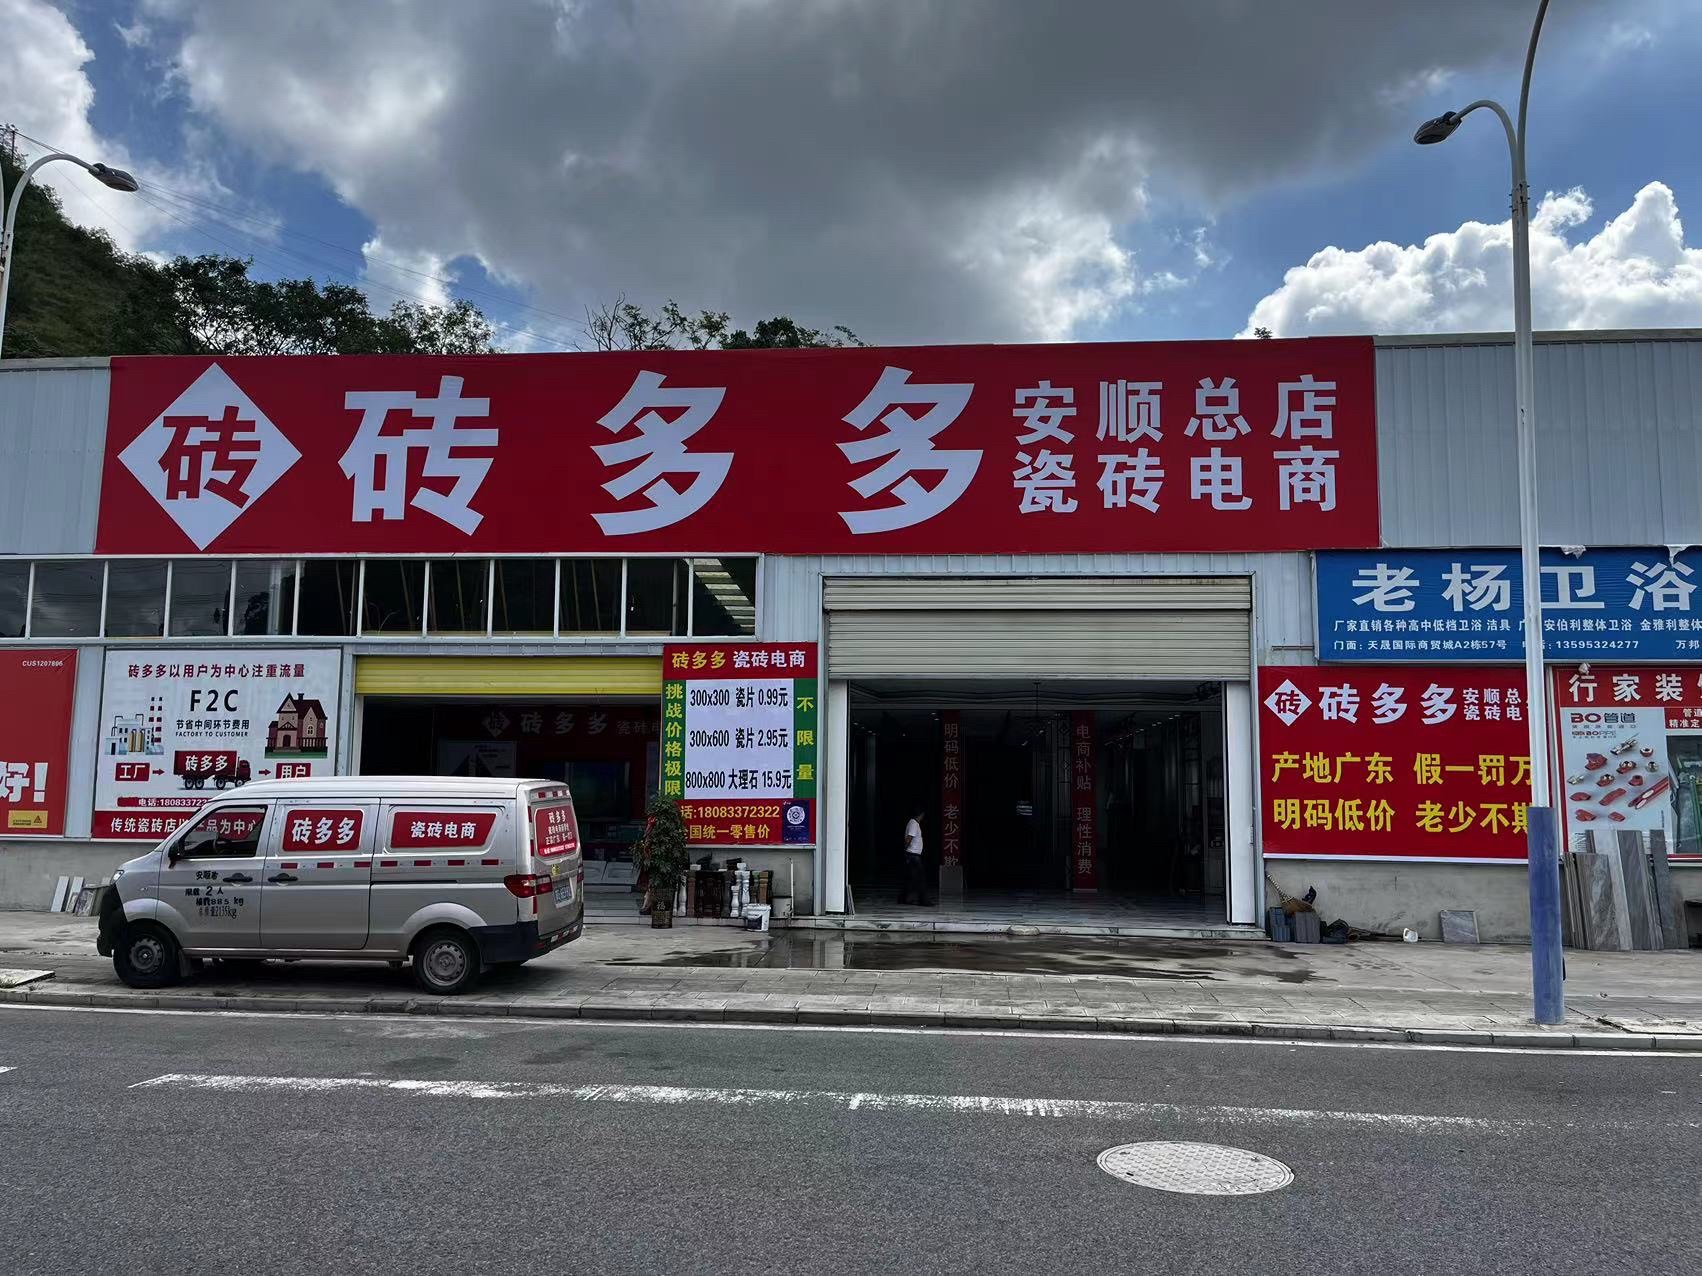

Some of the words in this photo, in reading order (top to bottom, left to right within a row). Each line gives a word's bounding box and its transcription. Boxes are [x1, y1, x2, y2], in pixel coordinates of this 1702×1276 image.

[1013, 374, 1337, 444] 安顺总店
[158, 405, 261, 509] 砖
[338, 366, 983, 537] 砖多多
[1013, 446, 1340, 514] 瓷砖电商
[1352, 561, 1697, 612] 老杨卫浴
[1519, 618, 1632, 632] 安伯利整体卫浴
[128, 663, 305, 678] 砖多多以用户为中心注重流量
[672, 650, 726, 669] 砖多多
[733, 650, 806, 669] 瓷砖电商
[190, 690, 239, 712] F2C
[690, 690, 730, 706] 300x300
[735, 687, 755, 708] 瓷片
[758, 687, 788, 707] 0.99元
[1462, 688, 1529, 705] 安顺总
[1568, 674, 1702, 703] 行家装
[1318, 683, 1458, 725] 砖多多
[1463, 704, 1529, 722] 瓷砖电
[176, 719, 250, 730] 节省中间环节费用
[664, 683, 683, 796] 挑战价格极限
[689, 730, 729, 747] 300x600
[735, 728, 755, 749] 瓷片
[757, 729, 788, 748] 2.95元
[797, 697, 814, 780] 不限量
[185, 755, 228, 772] 砖多多
[943, 722, 960, 789] 明码低价
[1076, 725, 1093, 791] 电商补贴
[119, 764, 146, 779] 工厂
[281, 765, 307, 779] 用户
[685, 771, 725, 789] 800x800
[728, 768, 758, 790] 大理石
[761, 770, 792, 790] 15.9元
[1272, 752, 1394, 785] 产地广东
[1273, 799, 1395, 832] 明码低价
[292, 816, 355, 845] 砖多多
[411, 821, 477, 839] 瓷砖电商
[1077, 807, 1093, 875] 理性消费
